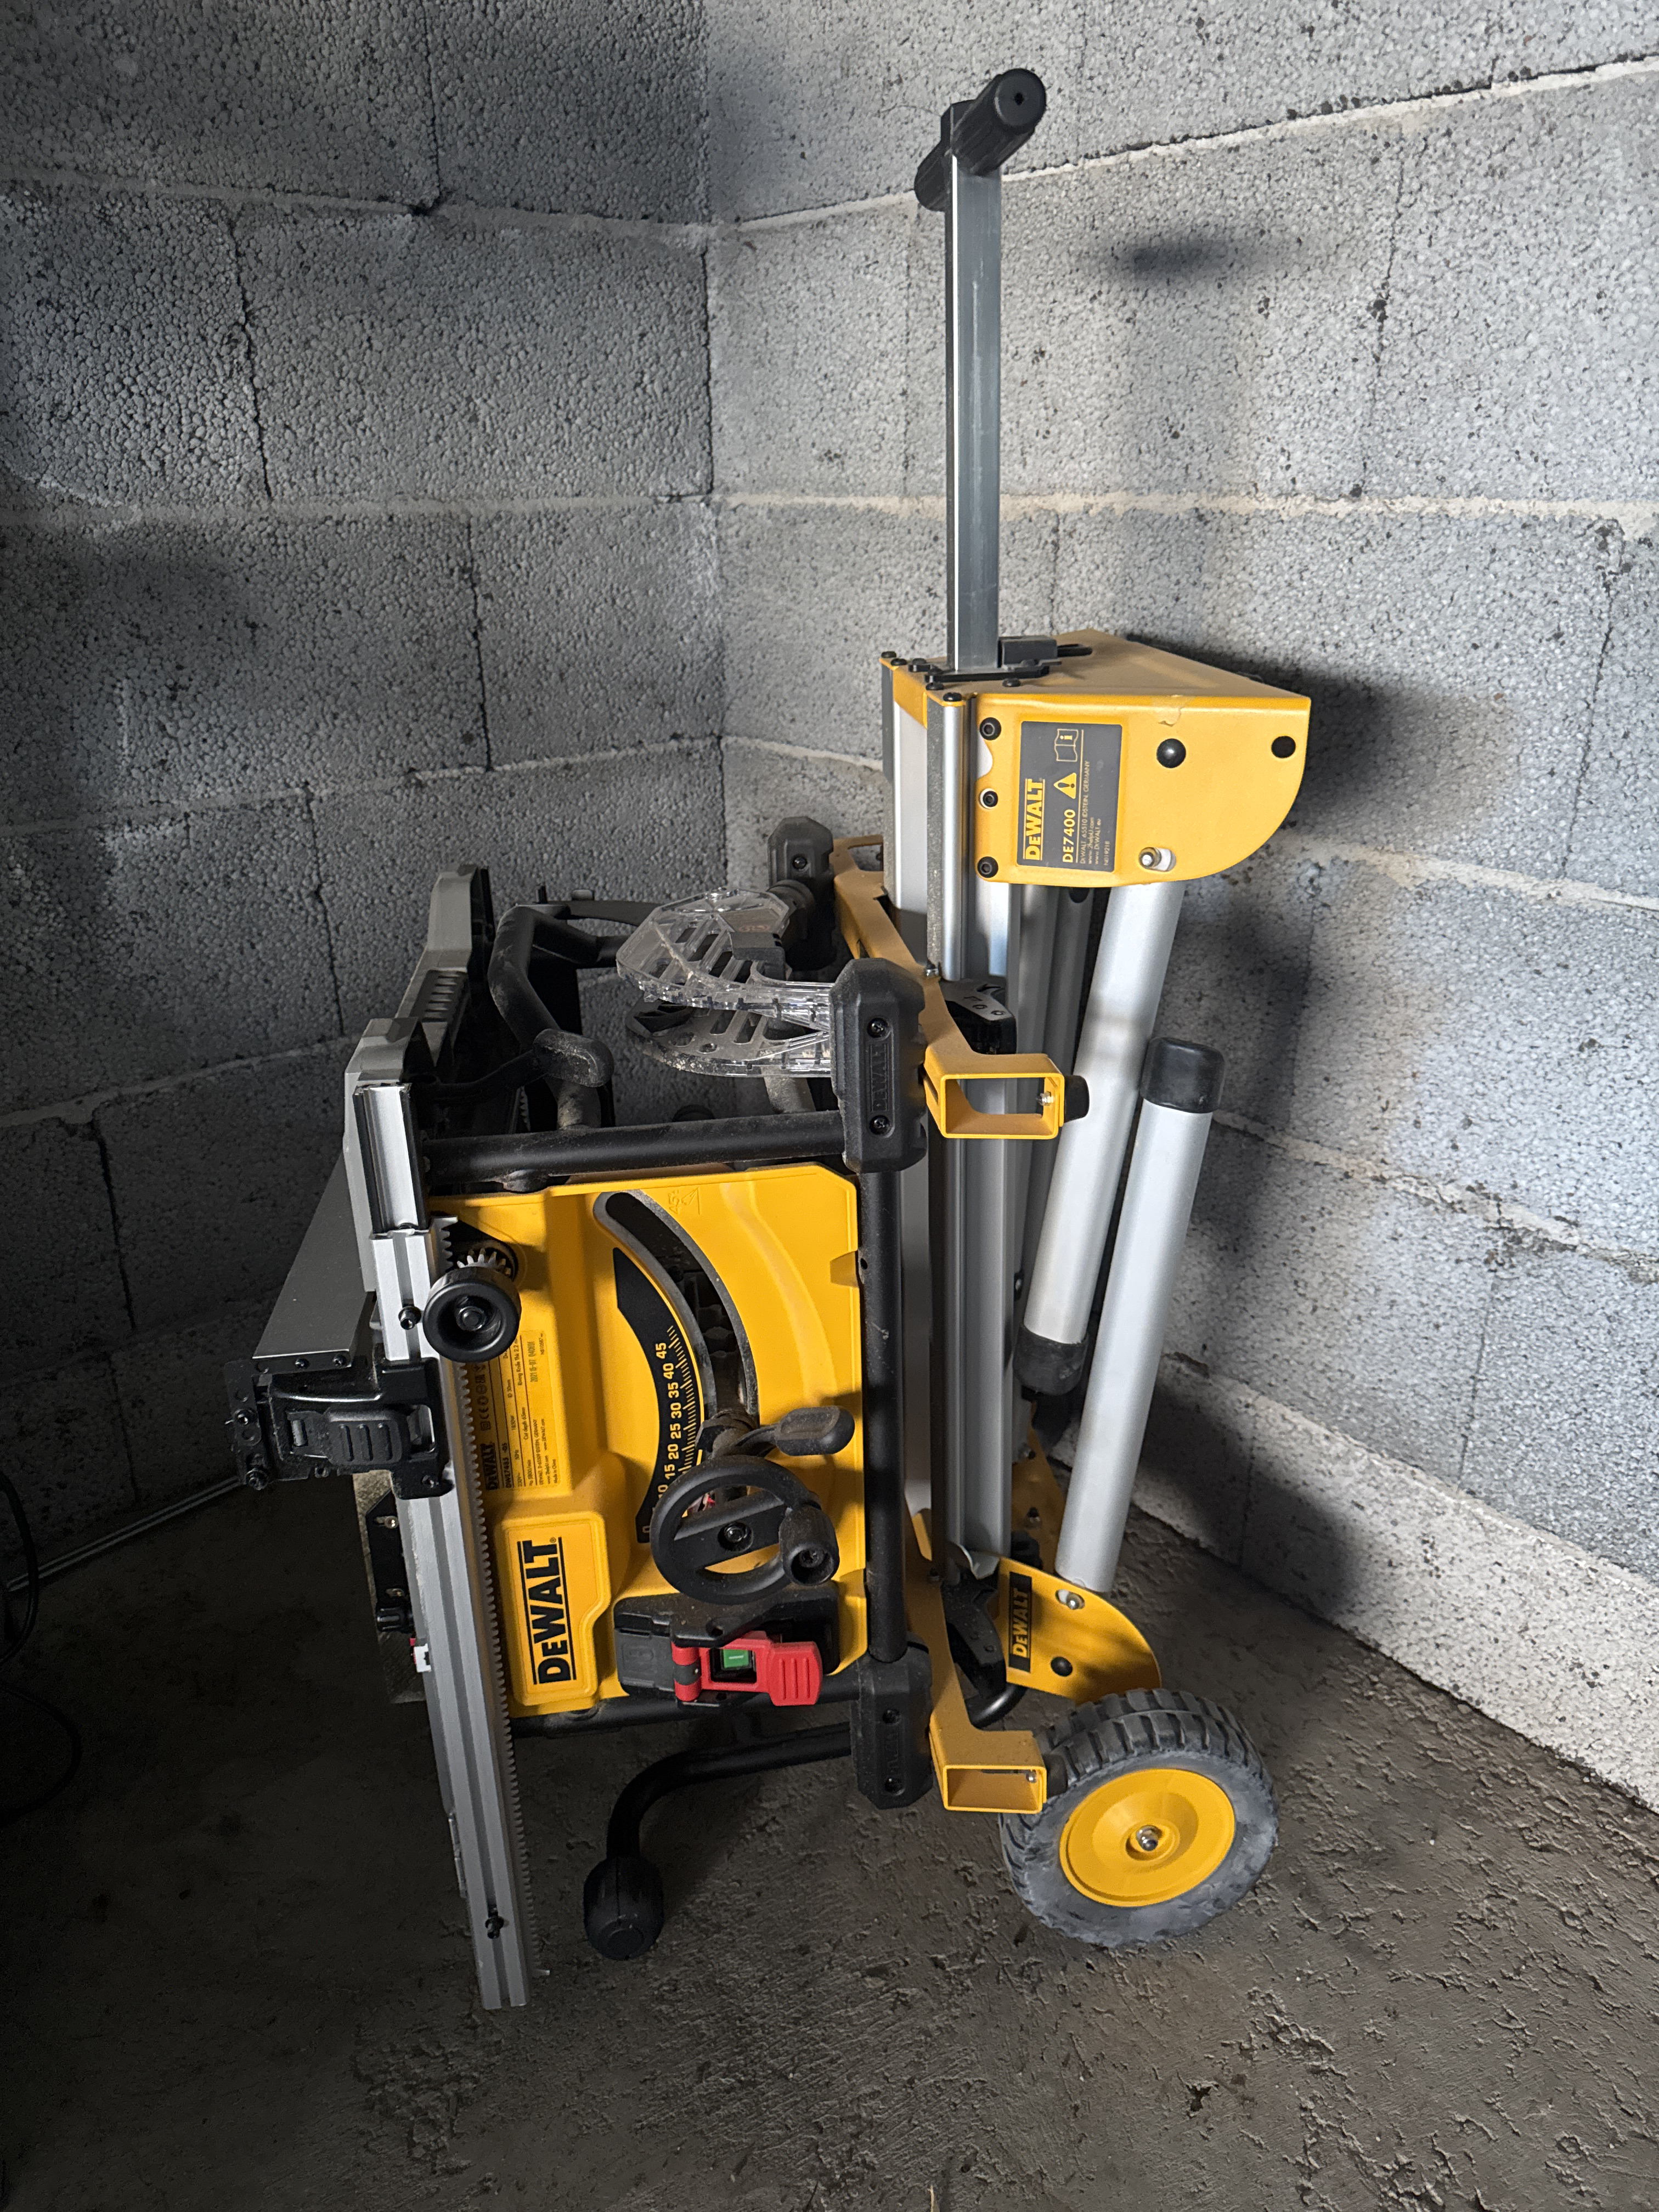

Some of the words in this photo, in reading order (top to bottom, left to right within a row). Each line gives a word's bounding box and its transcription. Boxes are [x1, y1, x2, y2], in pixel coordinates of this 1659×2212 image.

[1063, 809, 1075, 862] DE7400
[656, 1342, 667, 1359] 45
[663, 1363, 674, 1379] 40
[668, 1382, 679, 1398] 35
[671, 1402, 681, 1418] 30
[670, 1423, 681, 1439] 25
[668, 1443, 679, 1459] 20
[665, 1464, 675, 1479] 15
